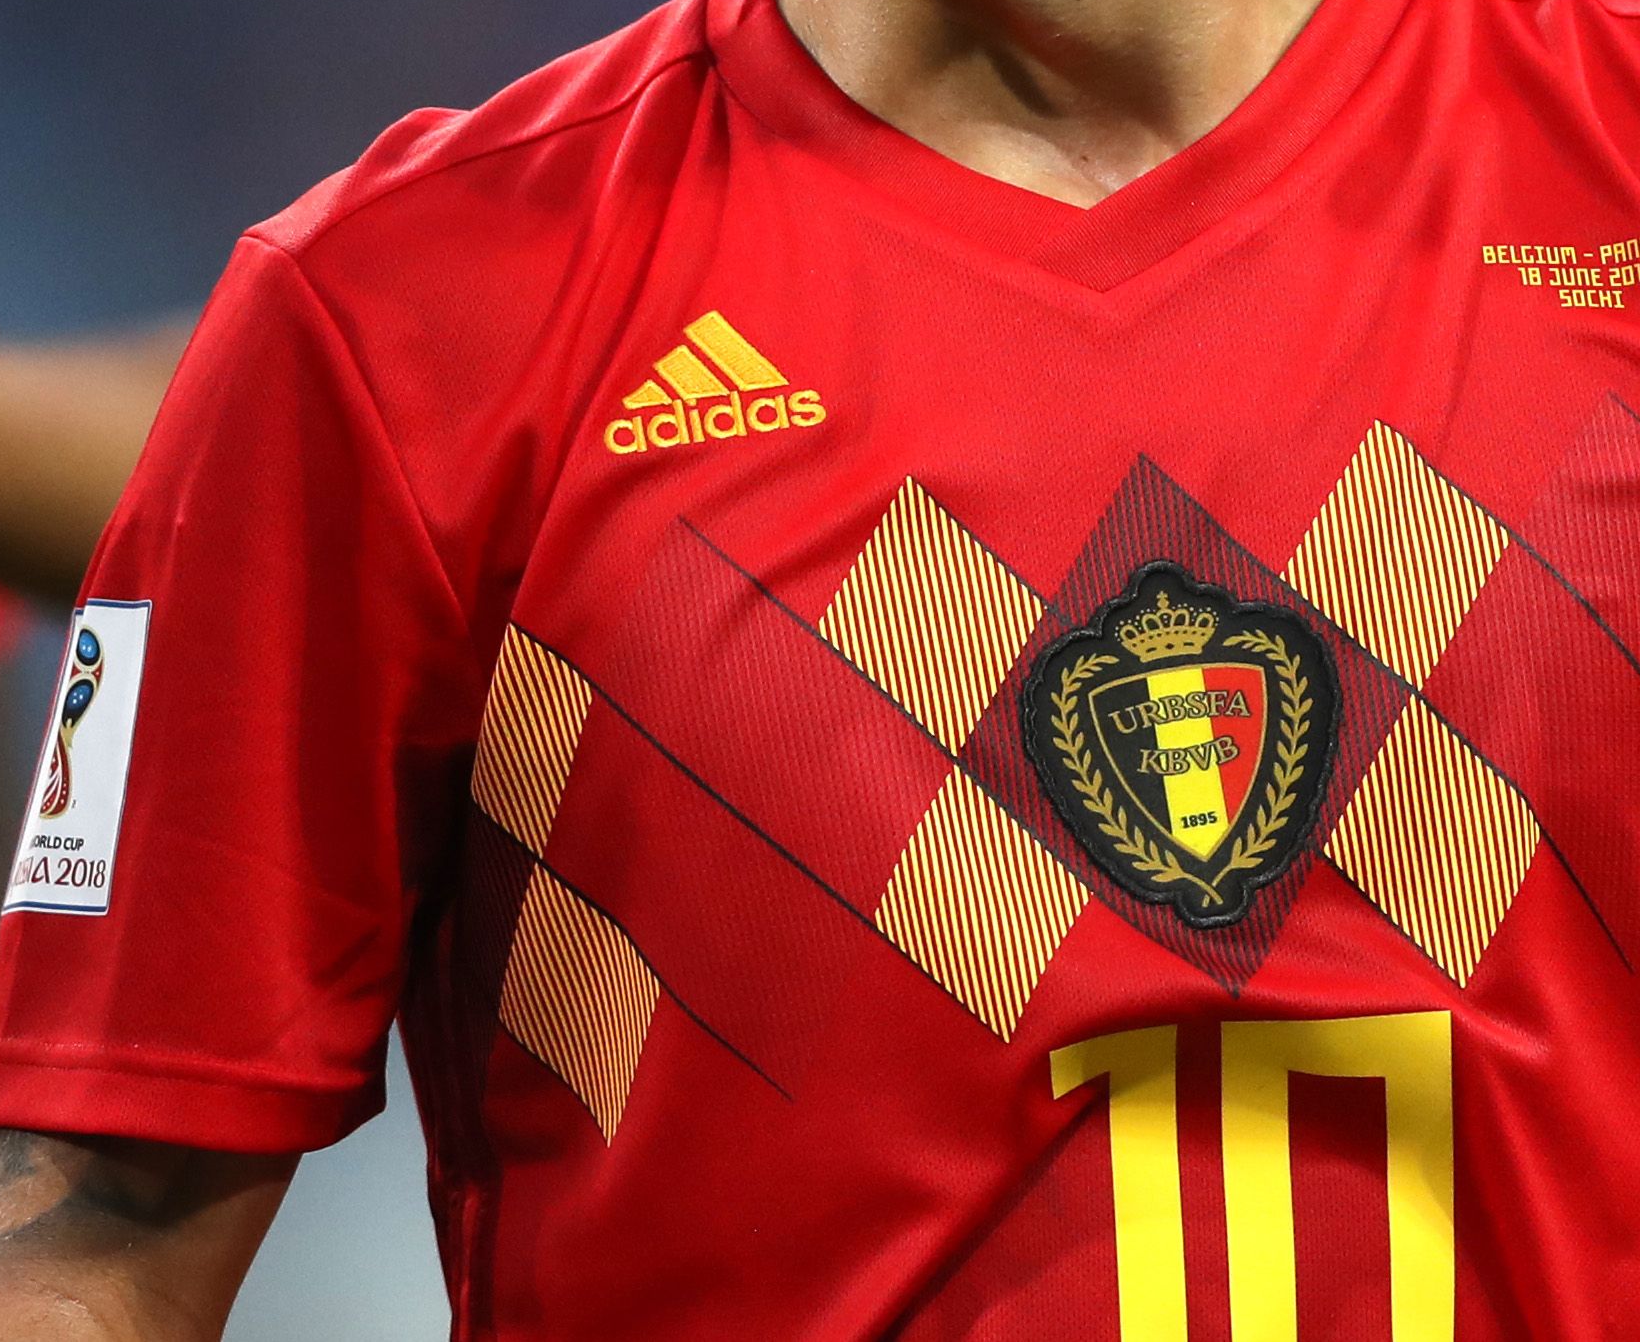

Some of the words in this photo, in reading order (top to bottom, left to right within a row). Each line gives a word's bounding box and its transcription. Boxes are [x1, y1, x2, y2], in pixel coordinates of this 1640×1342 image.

[1482, 245, 1577, 265] BELGIUM
[1518, 267, 1542, 286] 18
[1549, 268, 1604, 287] JUNE
[1559, 289, 1625, 309] SOCHI
[603, 389, 827, 455] adidas
[1107, 690, 1251, 734] URBSFA
[1136, 735, 1240, 776] KBVB
[1179, 811, 1218, 829] 1895
[63, 837, 85, 851] CUP
[54, 857, 107, 889] 2018
